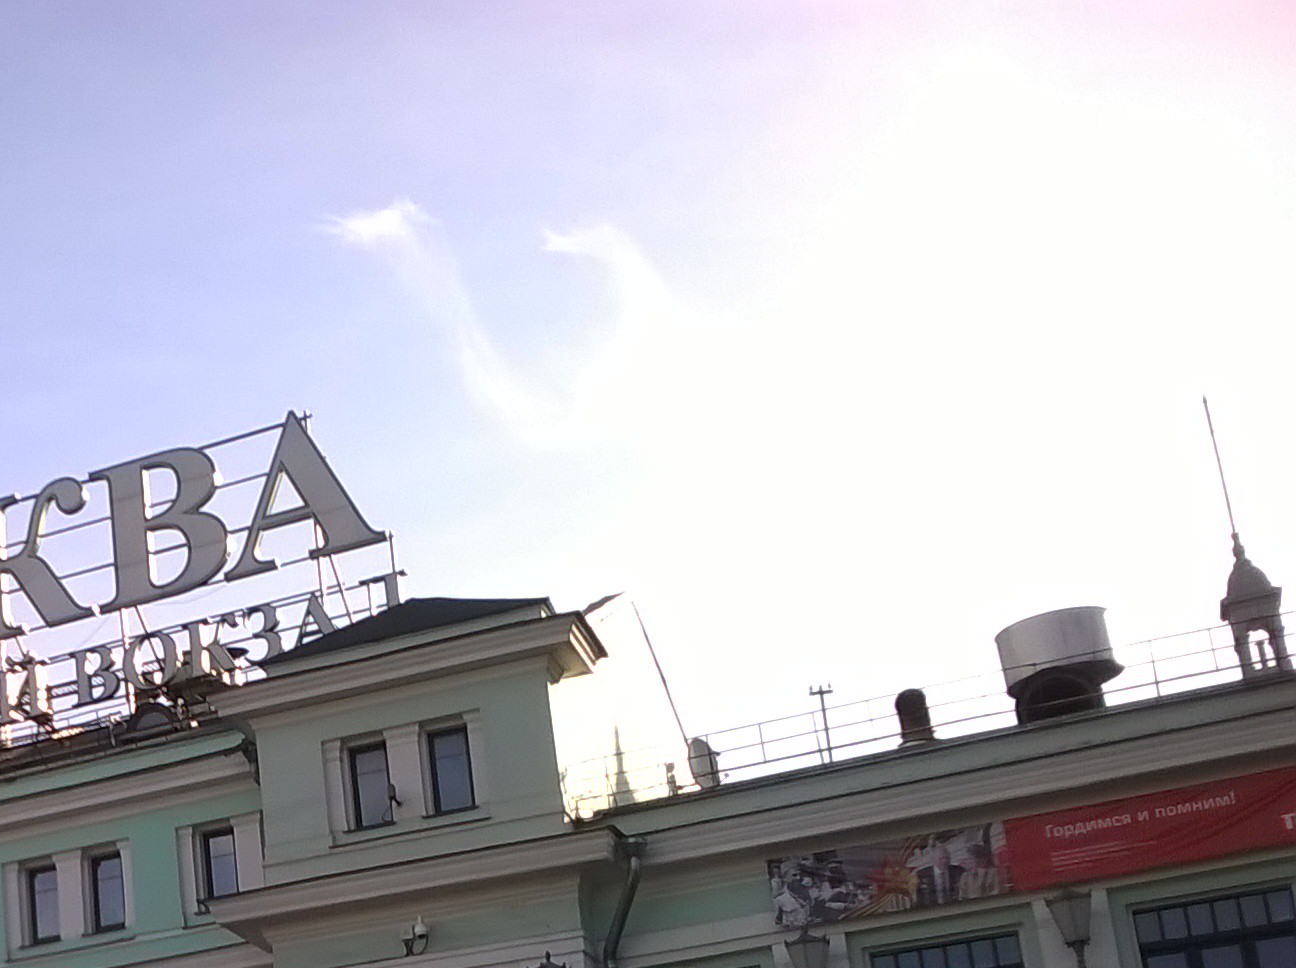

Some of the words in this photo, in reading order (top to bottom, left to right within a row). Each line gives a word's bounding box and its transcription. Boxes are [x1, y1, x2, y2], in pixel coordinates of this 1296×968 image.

[1044, 813, 1132, 839] Гордимся
[1137, 809, 1150, 823] и
[1154, 790, 1237, 819] помним!
